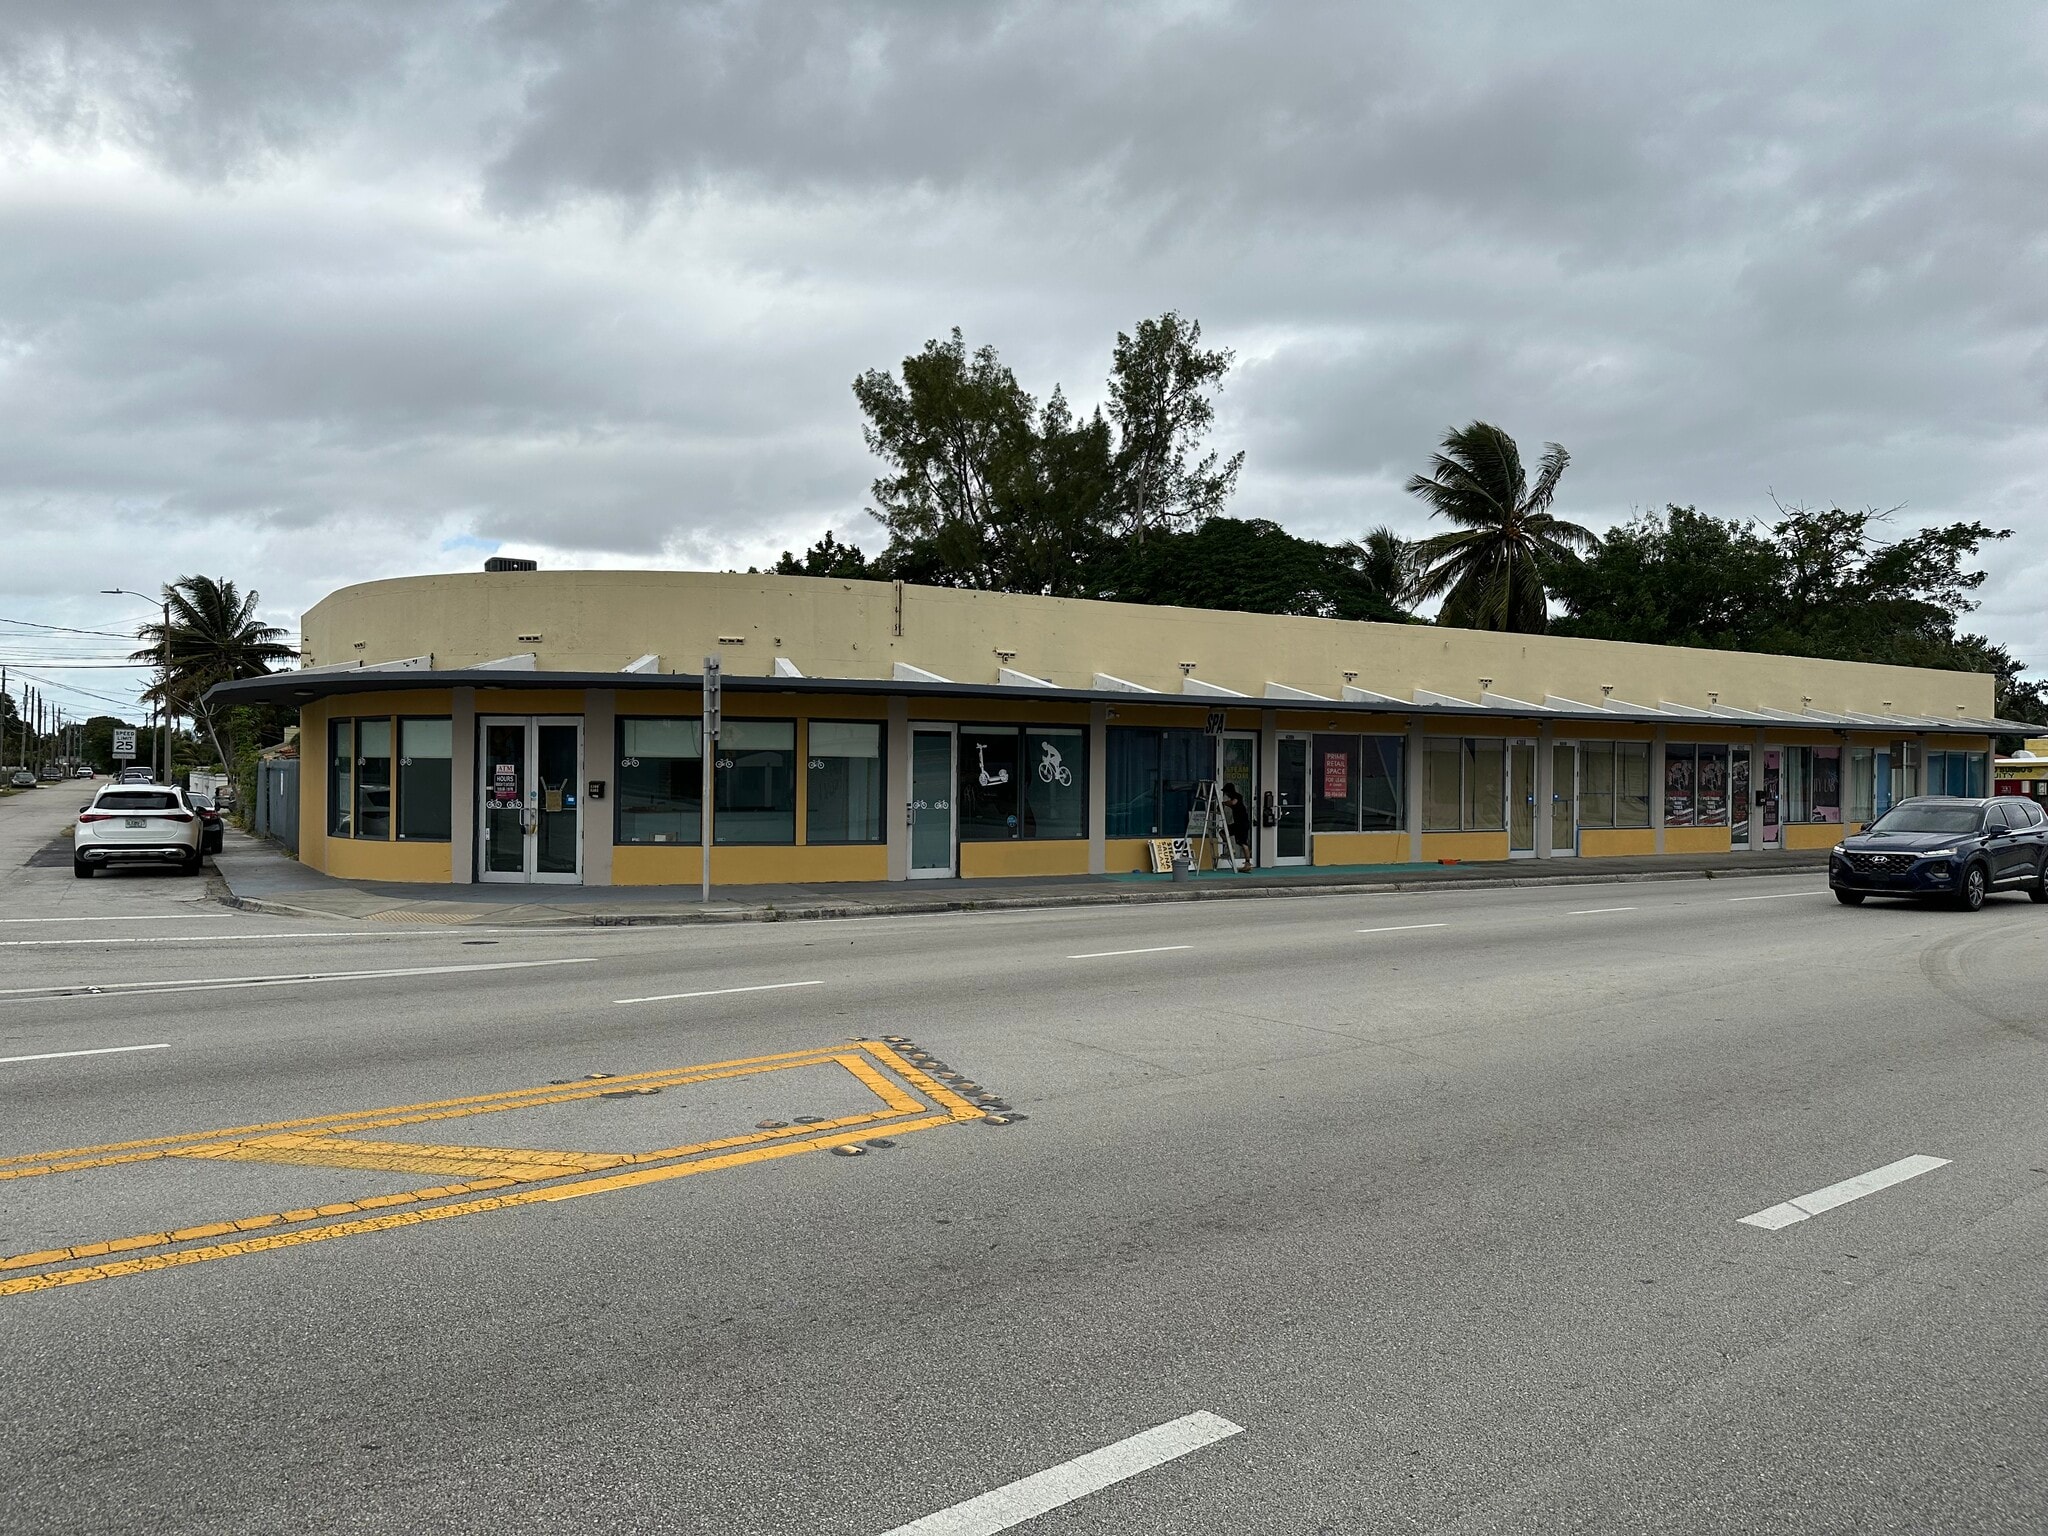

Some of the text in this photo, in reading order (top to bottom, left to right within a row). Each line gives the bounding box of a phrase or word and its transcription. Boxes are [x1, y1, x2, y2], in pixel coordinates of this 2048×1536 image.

[1205, 713, 1225, 734] SPA
[116, 741, 134, 750] 25
[1161, 841, 1171, 870] SAUNA
